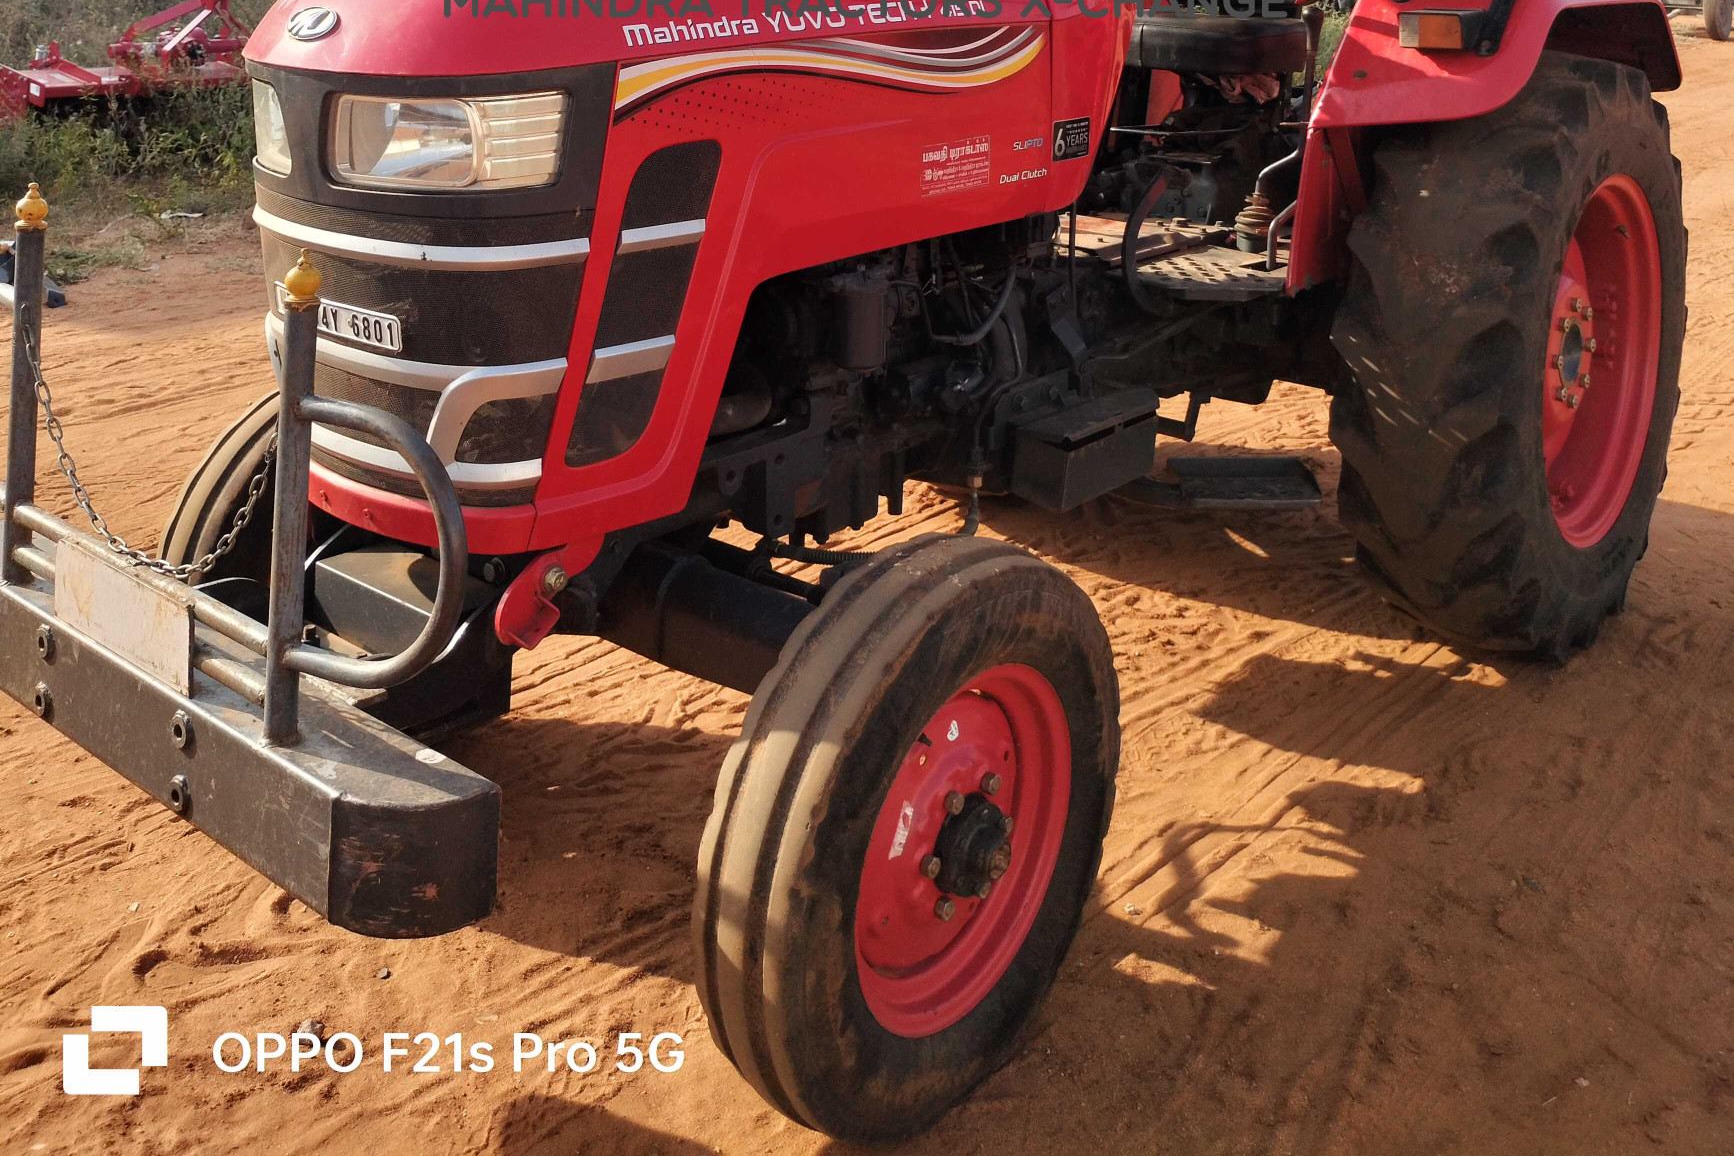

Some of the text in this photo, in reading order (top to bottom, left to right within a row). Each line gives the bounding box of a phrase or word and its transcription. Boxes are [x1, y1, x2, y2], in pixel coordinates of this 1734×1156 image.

[622, 15, 759, 47] Mahindra
[761, 5, 846, 33] YUVO
[1054, 128, 1066, 157] 6
[1066, 131, 1089, 146] YEARS
[999, 172, 1020, 185] Dual
[1021, 167, 1048, 180] Clutch
[350, 313, 394, 347] 6801
